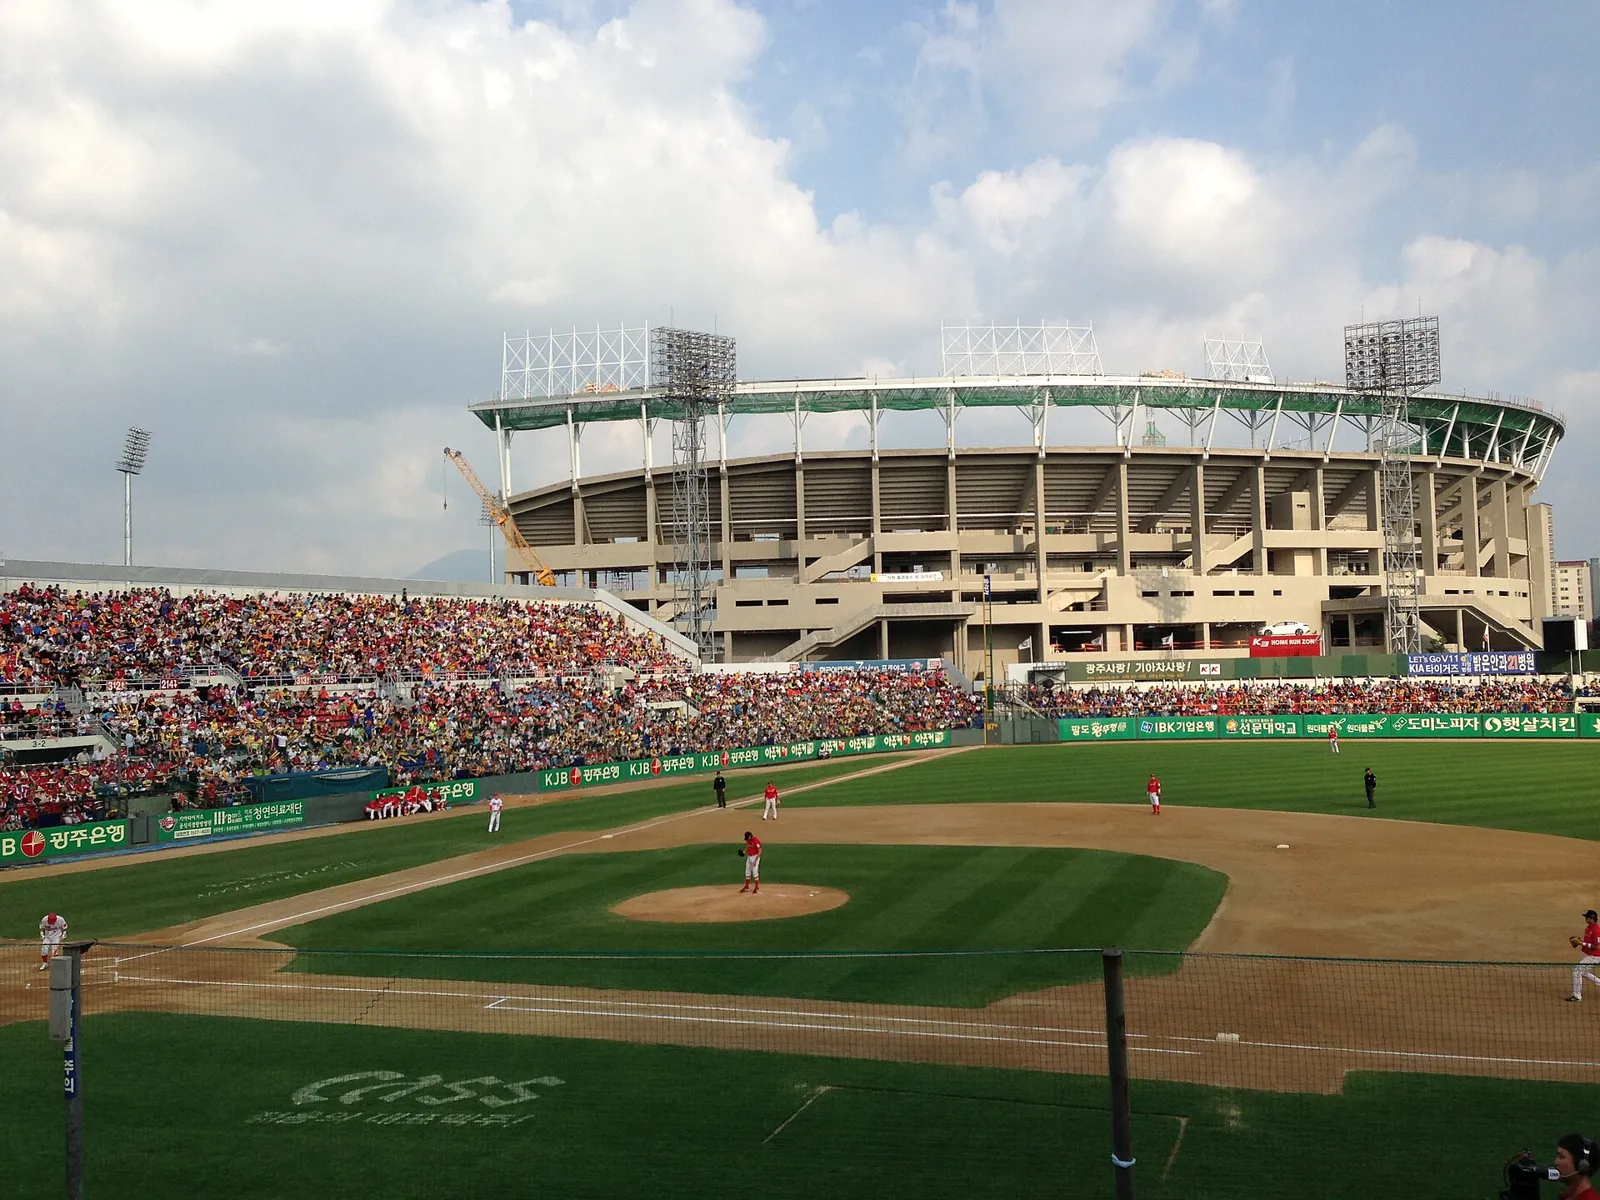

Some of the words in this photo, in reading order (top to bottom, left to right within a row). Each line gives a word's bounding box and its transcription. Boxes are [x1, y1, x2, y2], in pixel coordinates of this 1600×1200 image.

[1085, 662, 1131, 675] 광주사랑!
[1134, 661, 1192, 673] 기아차사랑!
[1408, 664, 1425, 673] KIA
[1425, 664, 1460, 673] 타이거즈
[1472, 653, 1535, 671] 밝은안과21병원
[1070, 725, 1090, 737] 팔도
[1154, 721, 1215, 733] IBK기업은행
[1239, 722, 1297, 735] 선문대학교
[1406, 717, 1480, 731] 도미노피자
[1501, 717, 1576, 732] 햇살치킨
[32, 740, 46, 748] 3-2
[702, 754, 720, 767] KJB
[730, 750, 759, 764] 광주은행
[629, 762, 650, 776] KJB
[662, 757, 694, 772] 광주은행
[545, 771, 568, 786] KJB
[583, 765, 620, 782] 광주은행
[253, 802, 303, 821] 청연의료재단
[49, 824, 125, 849] 광주은행
